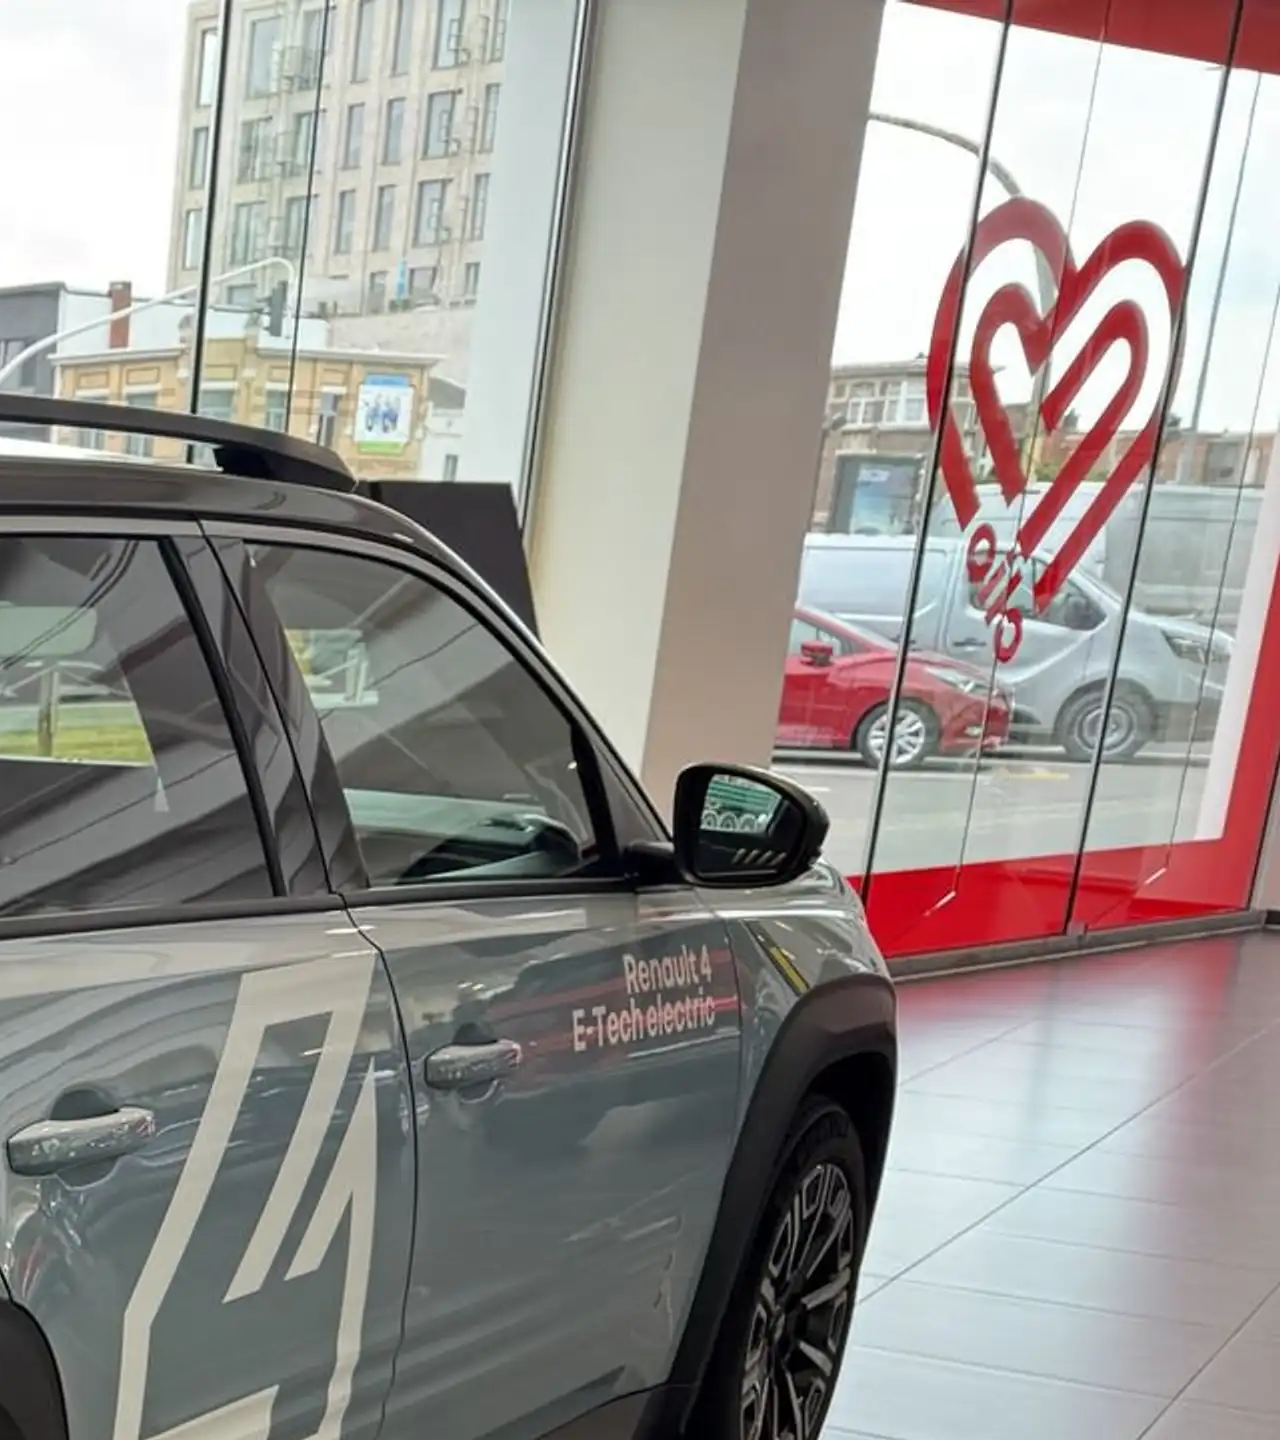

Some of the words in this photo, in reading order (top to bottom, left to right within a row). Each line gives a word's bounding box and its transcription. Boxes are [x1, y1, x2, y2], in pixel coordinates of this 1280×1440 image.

[623, 944, 699, 994] Renault
[700, 943, 713, 984] 4
[571, 998, 644, 1054] E-Tech
[646, 986, 717, 1039] electric
